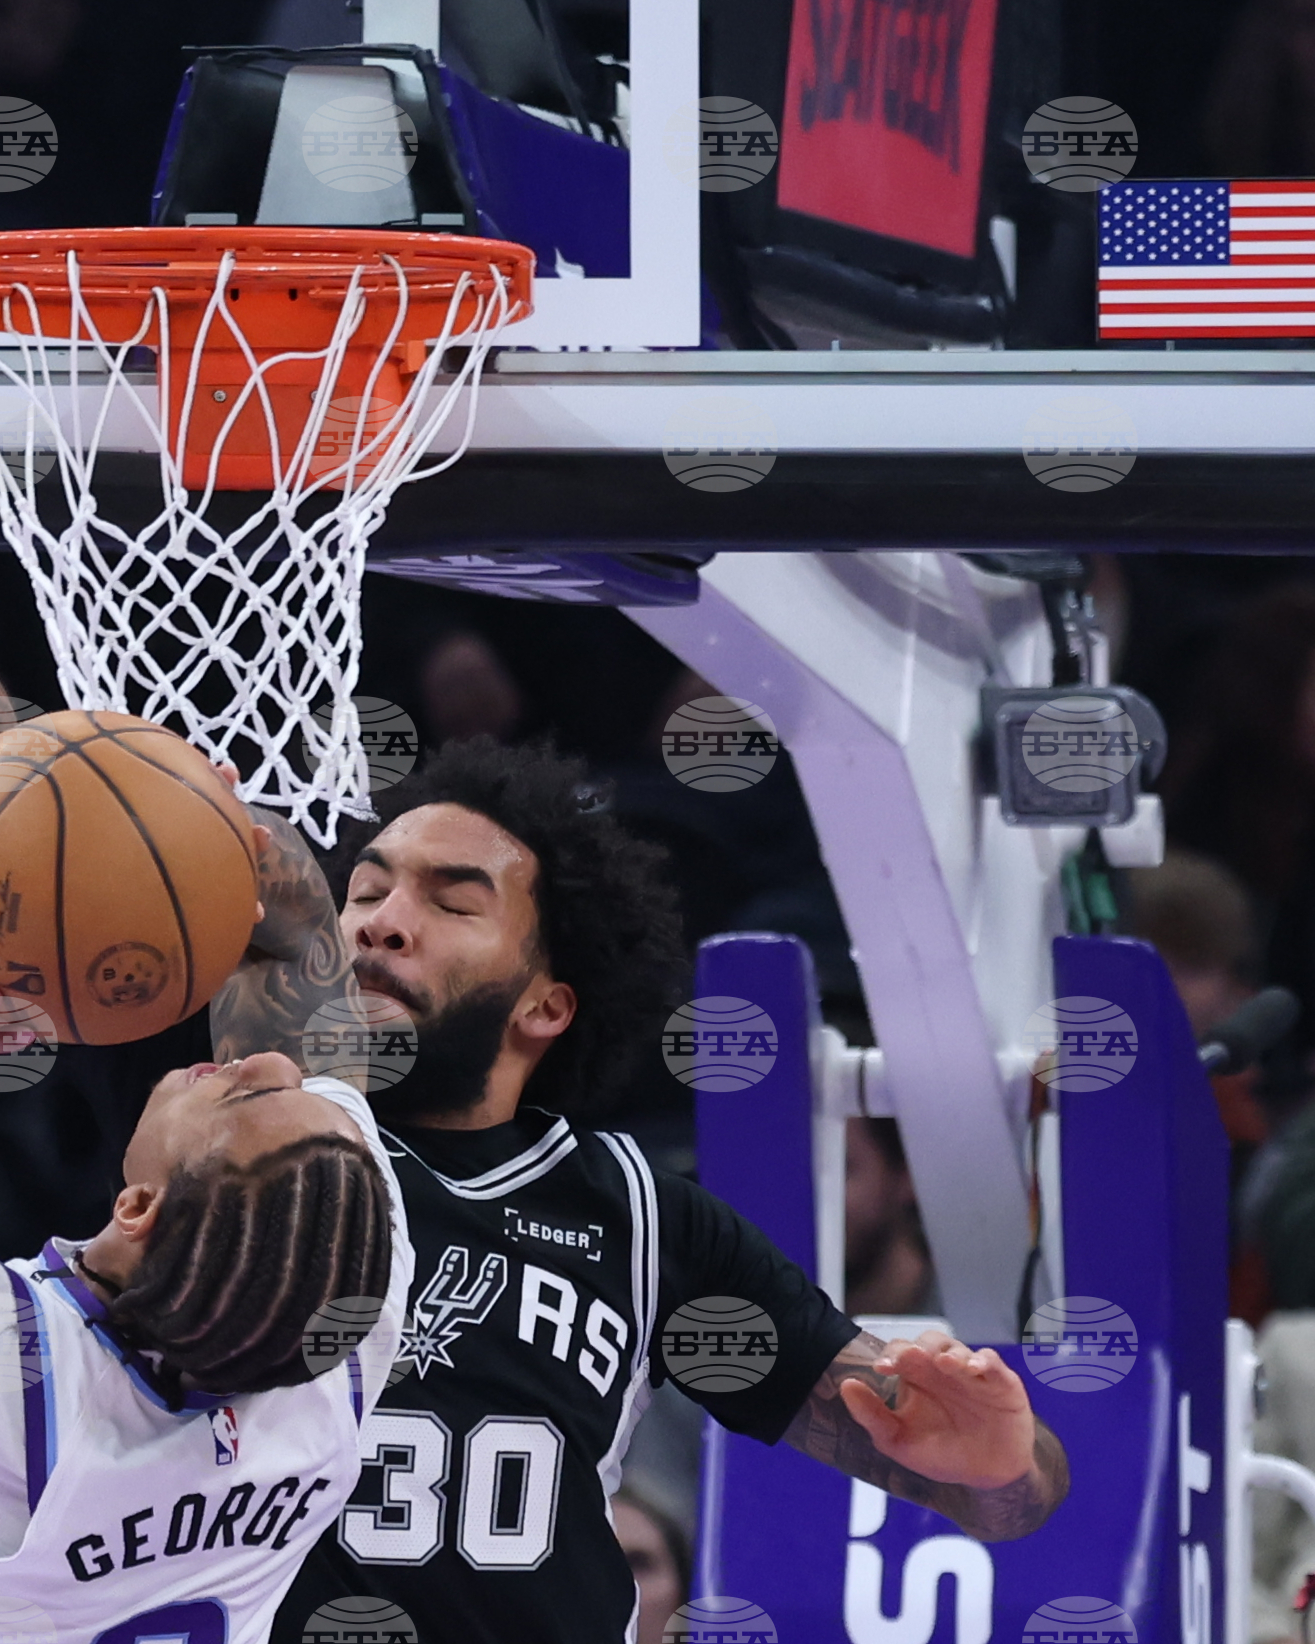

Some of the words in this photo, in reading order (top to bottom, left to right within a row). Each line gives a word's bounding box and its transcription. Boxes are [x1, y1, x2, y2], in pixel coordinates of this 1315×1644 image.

[516, 1217, 591, 1250] LEDGER
[65, 1476, 331, 1583] GEORGE
[337, 1407, 566, 1571] 30
